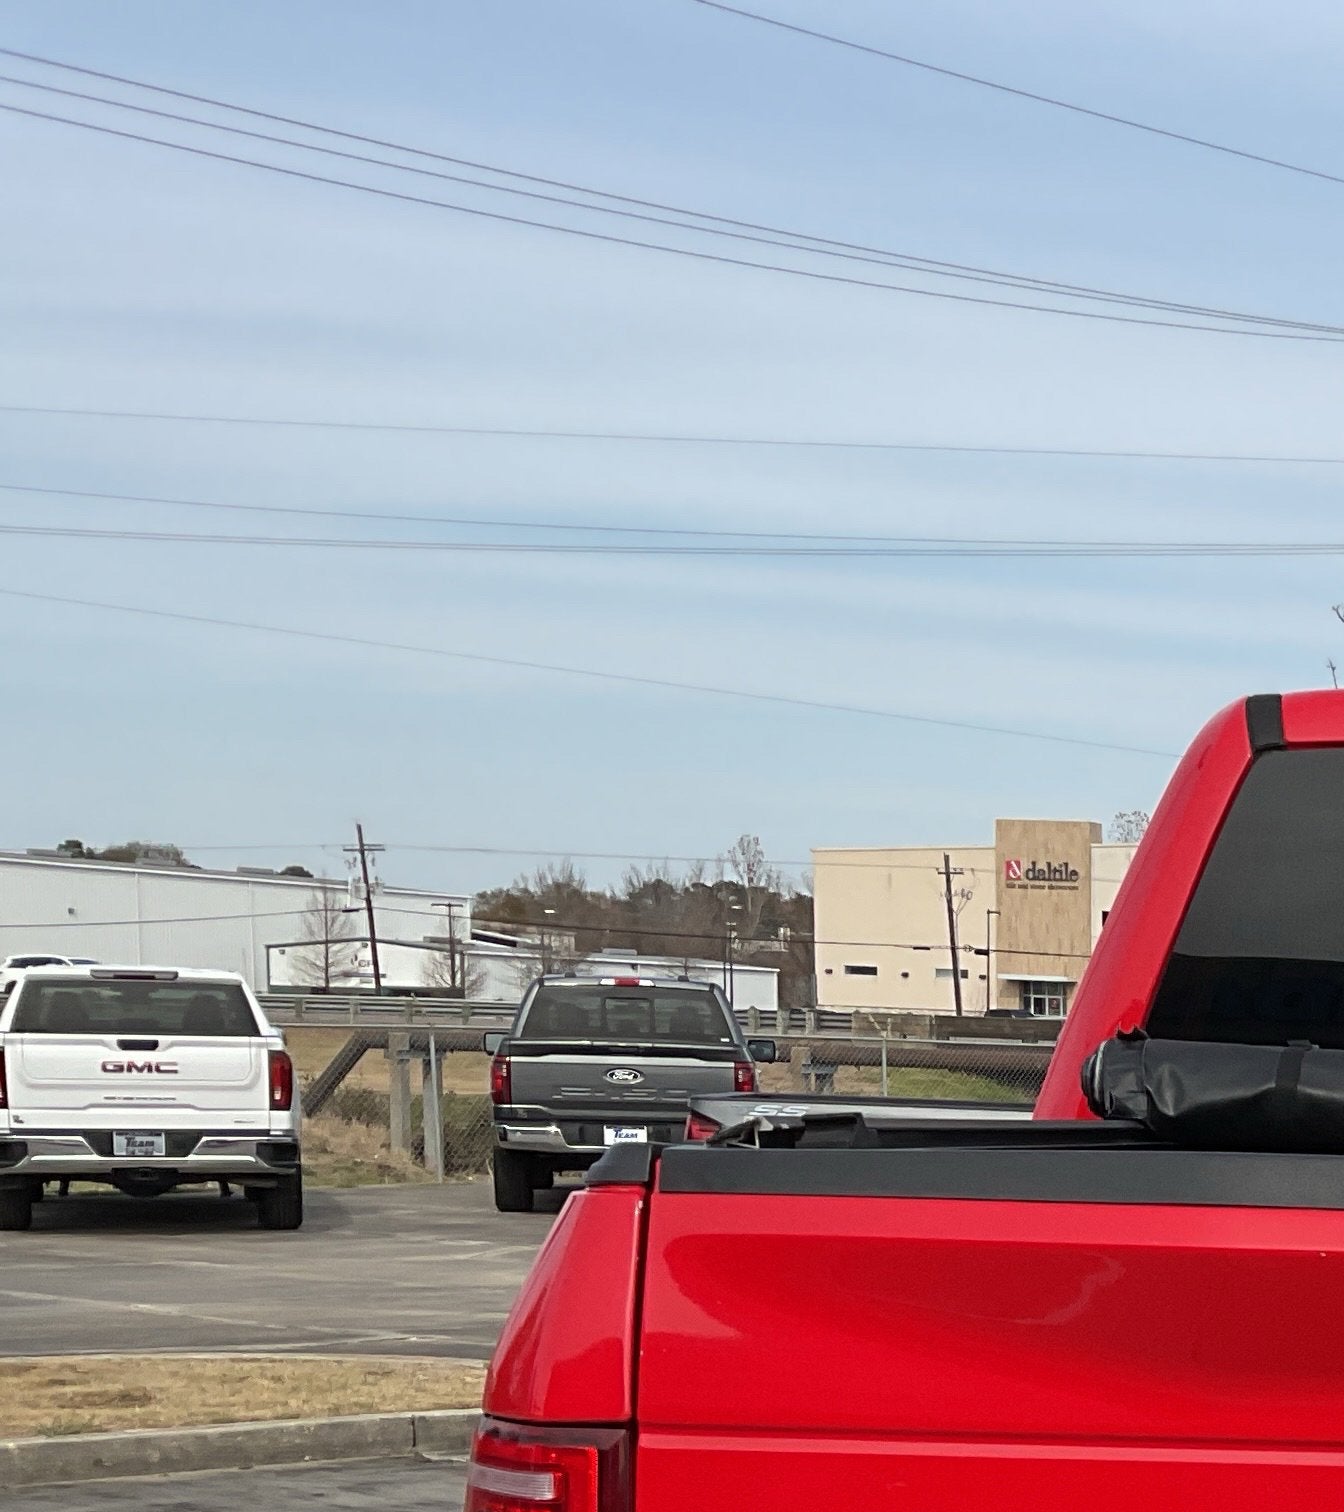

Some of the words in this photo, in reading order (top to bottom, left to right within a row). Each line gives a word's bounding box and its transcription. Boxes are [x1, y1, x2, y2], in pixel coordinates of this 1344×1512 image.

[1025, 861, 1079, 882] daltile
[101, 1060, 179, 1074] GMC
[748, 1104, 810, 1117] SS
